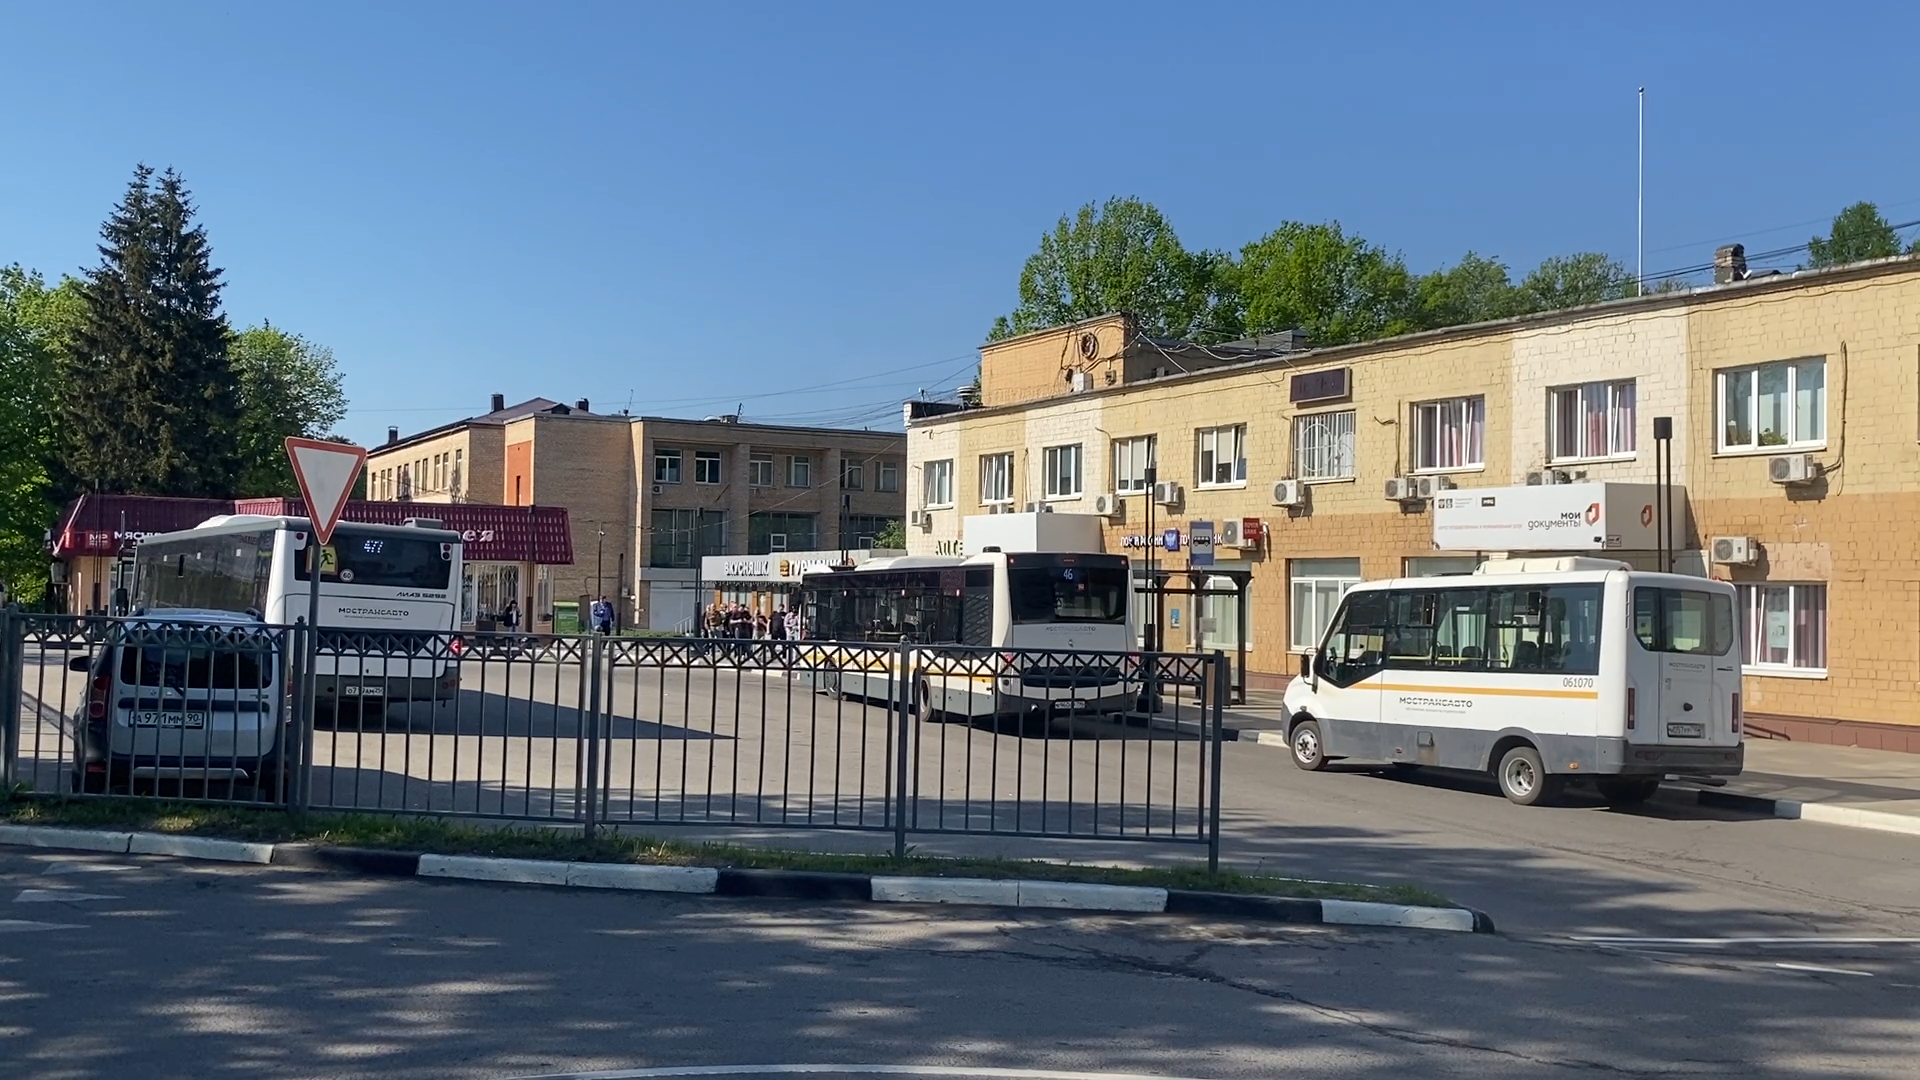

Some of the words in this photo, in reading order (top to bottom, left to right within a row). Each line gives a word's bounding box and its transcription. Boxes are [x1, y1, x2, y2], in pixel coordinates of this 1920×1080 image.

[342, 571, 352, 581] 60
[1063, 568, 1074, 580] 46
[1563, 677, 1594, 689] 061070
[1399, 696, 1473, 708] МОСТРАНСАВТО
